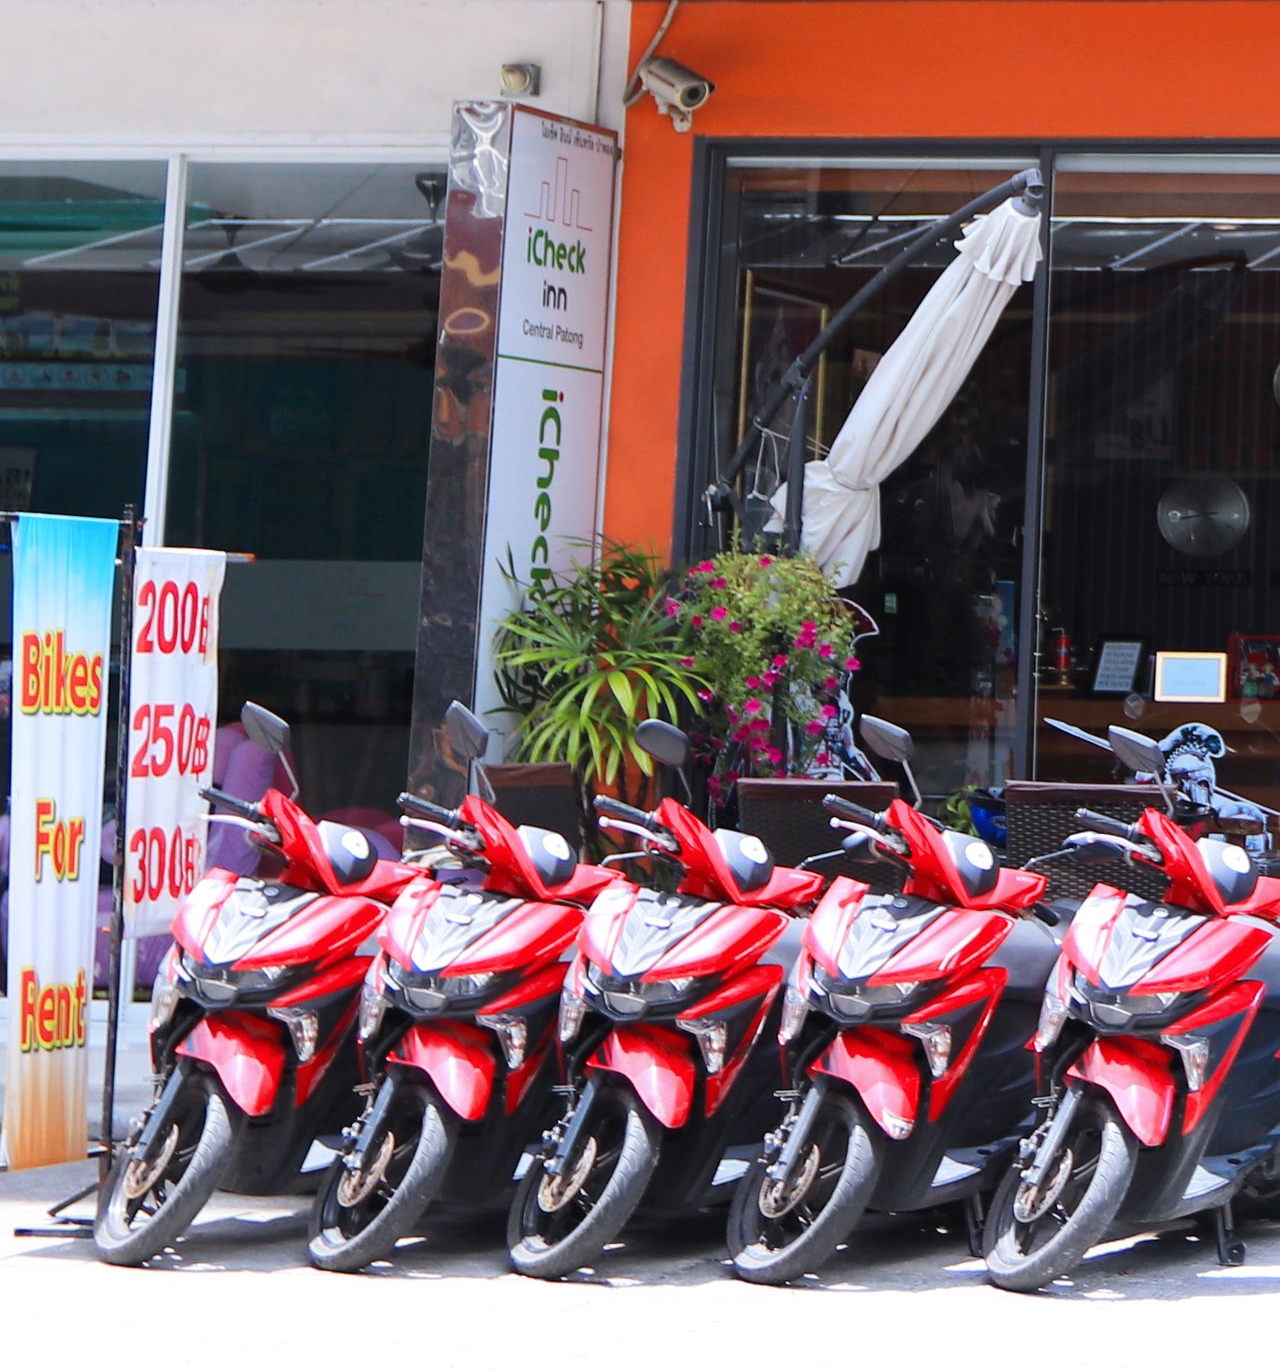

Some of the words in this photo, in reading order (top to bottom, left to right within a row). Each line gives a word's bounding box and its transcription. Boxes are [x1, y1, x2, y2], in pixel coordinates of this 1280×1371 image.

[527, 226, 586, 275] iCheck
[522, 319, 553, 340] Central
[555, 326, 584, 349] Patong
[542, 280, 567, 312] inn
[529, 388, 564, 602] iCheck
[20, 631, 102, 715] Bikes
[34, 798, 84, 881] For
[20, 966, 88, 1051] Rent
